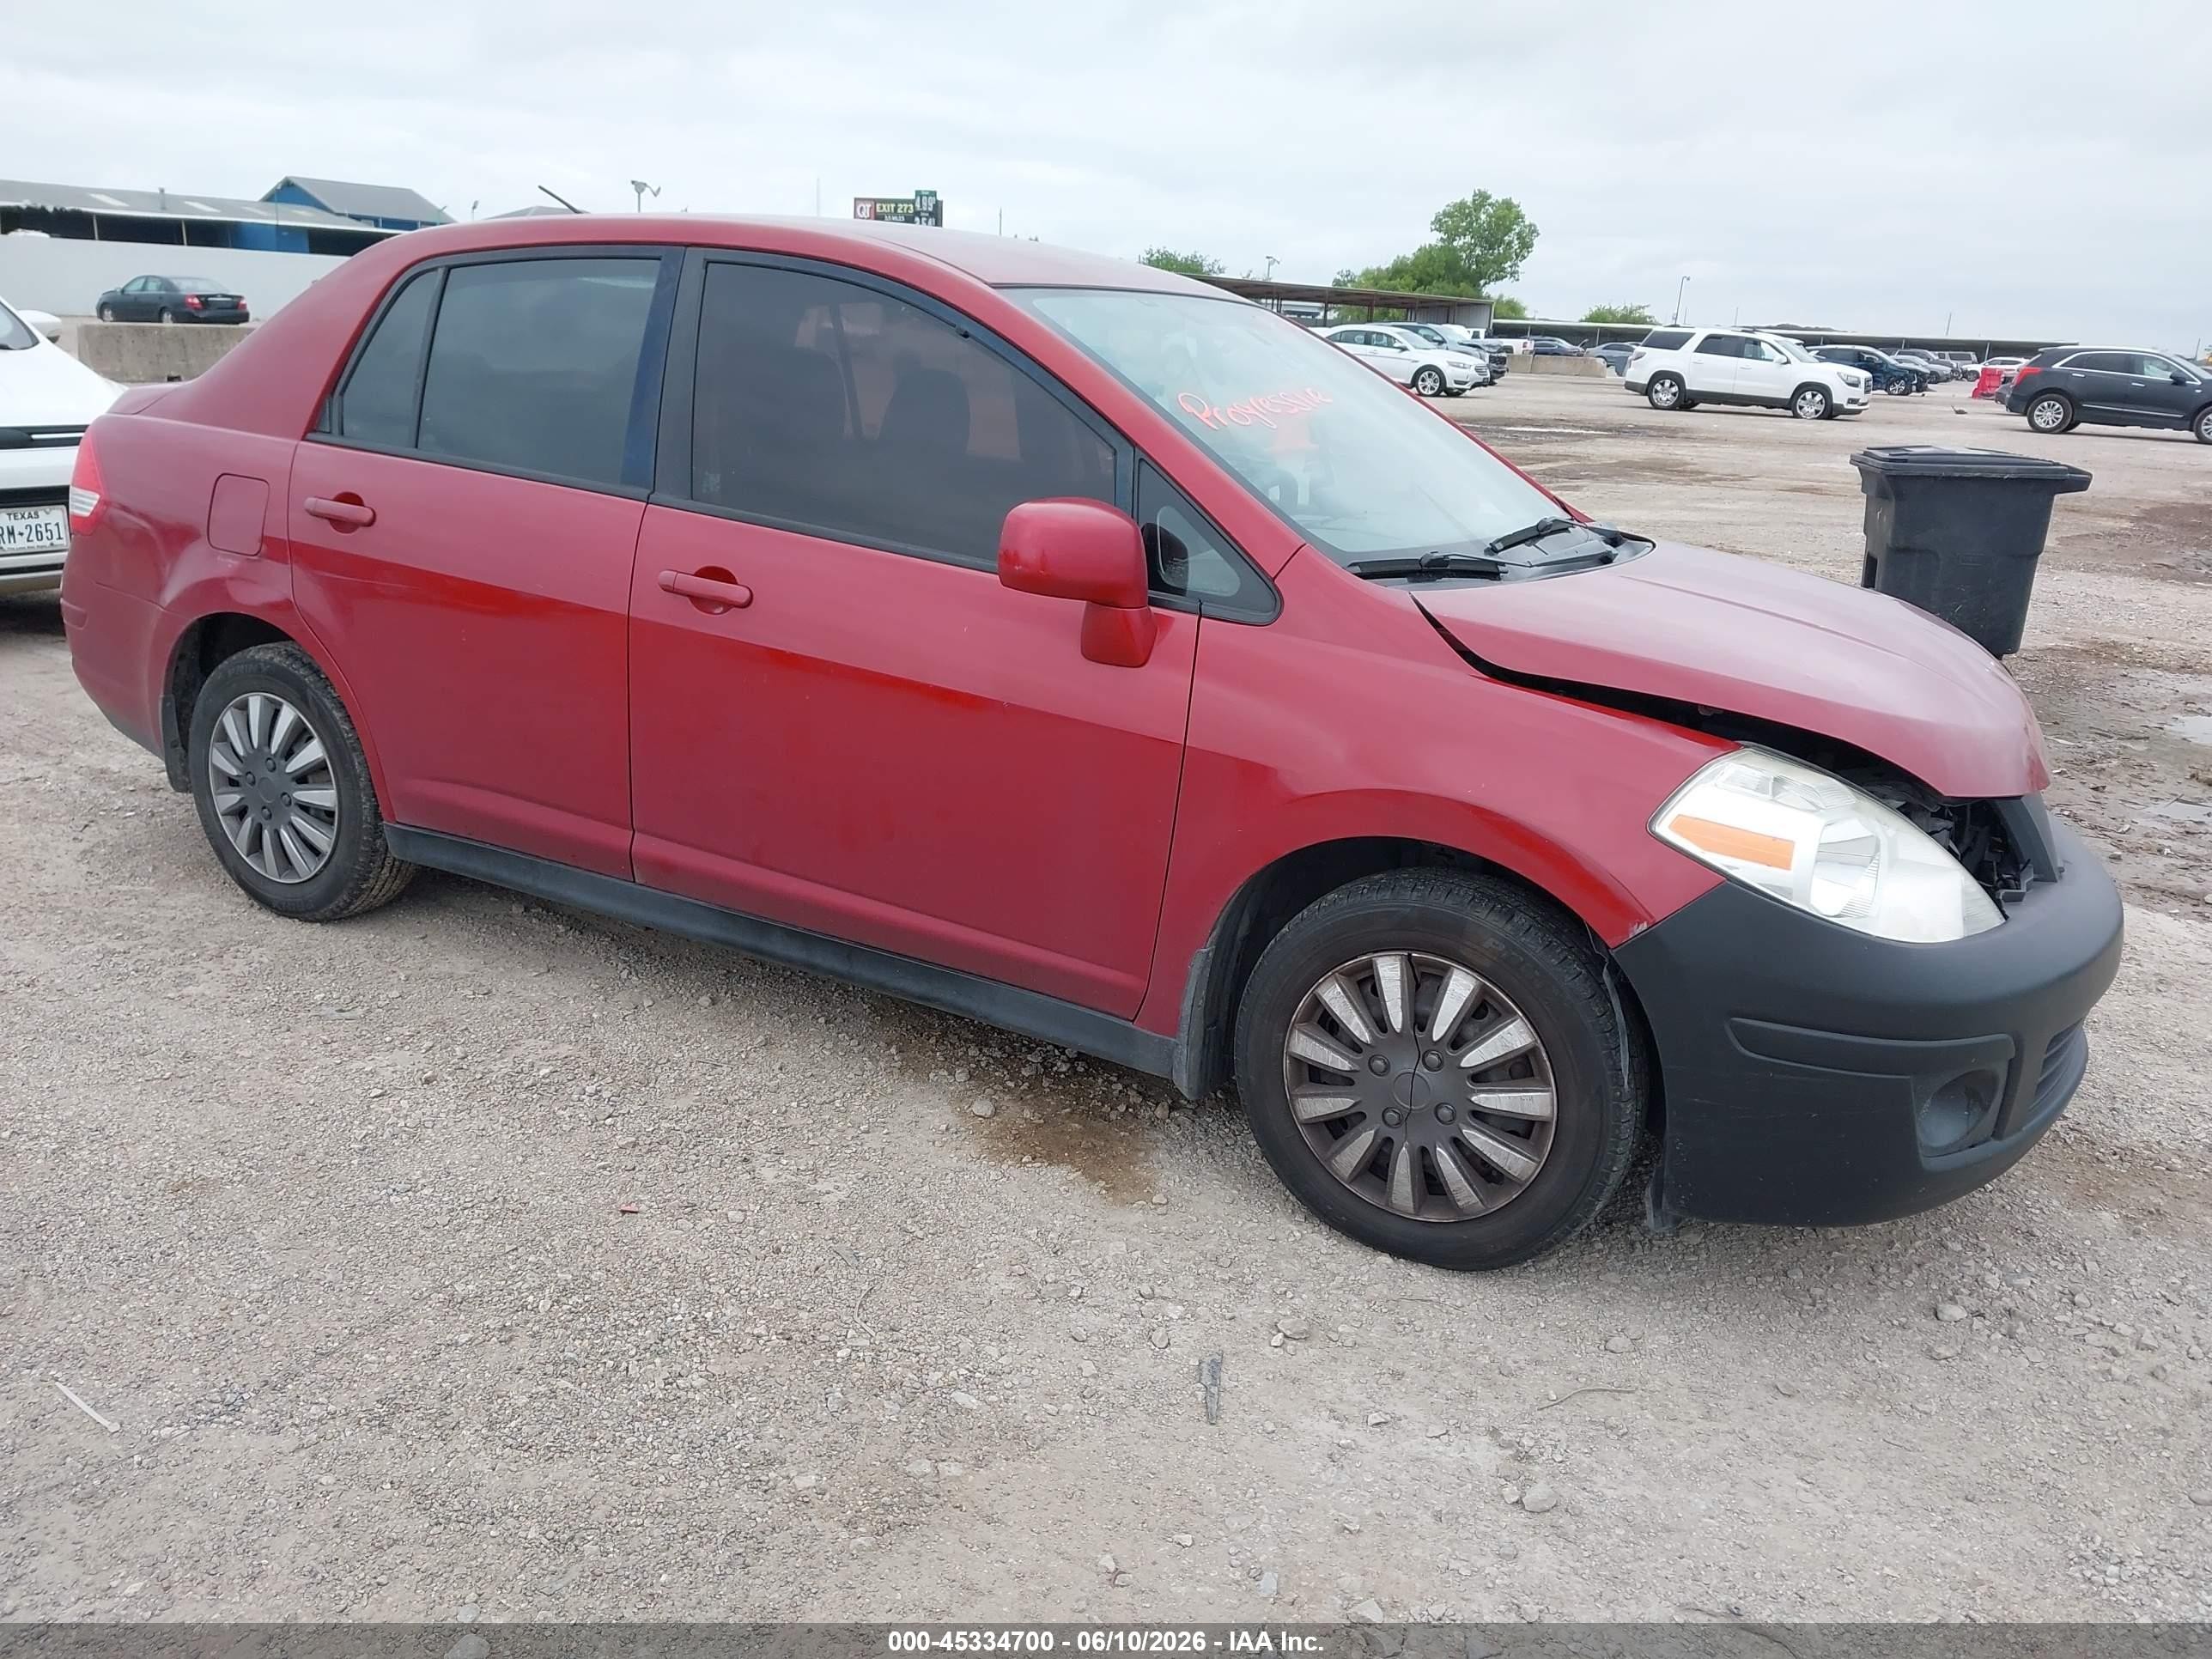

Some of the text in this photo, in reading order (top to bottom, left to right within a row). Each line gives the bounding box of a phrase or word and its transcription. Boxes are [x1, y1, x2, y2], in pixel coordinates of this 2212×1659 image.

[857, 204, 872, 219] QT
[876, 204, 915, 214] EXIT 273
[6, 511, 40, 521] TEXAS
